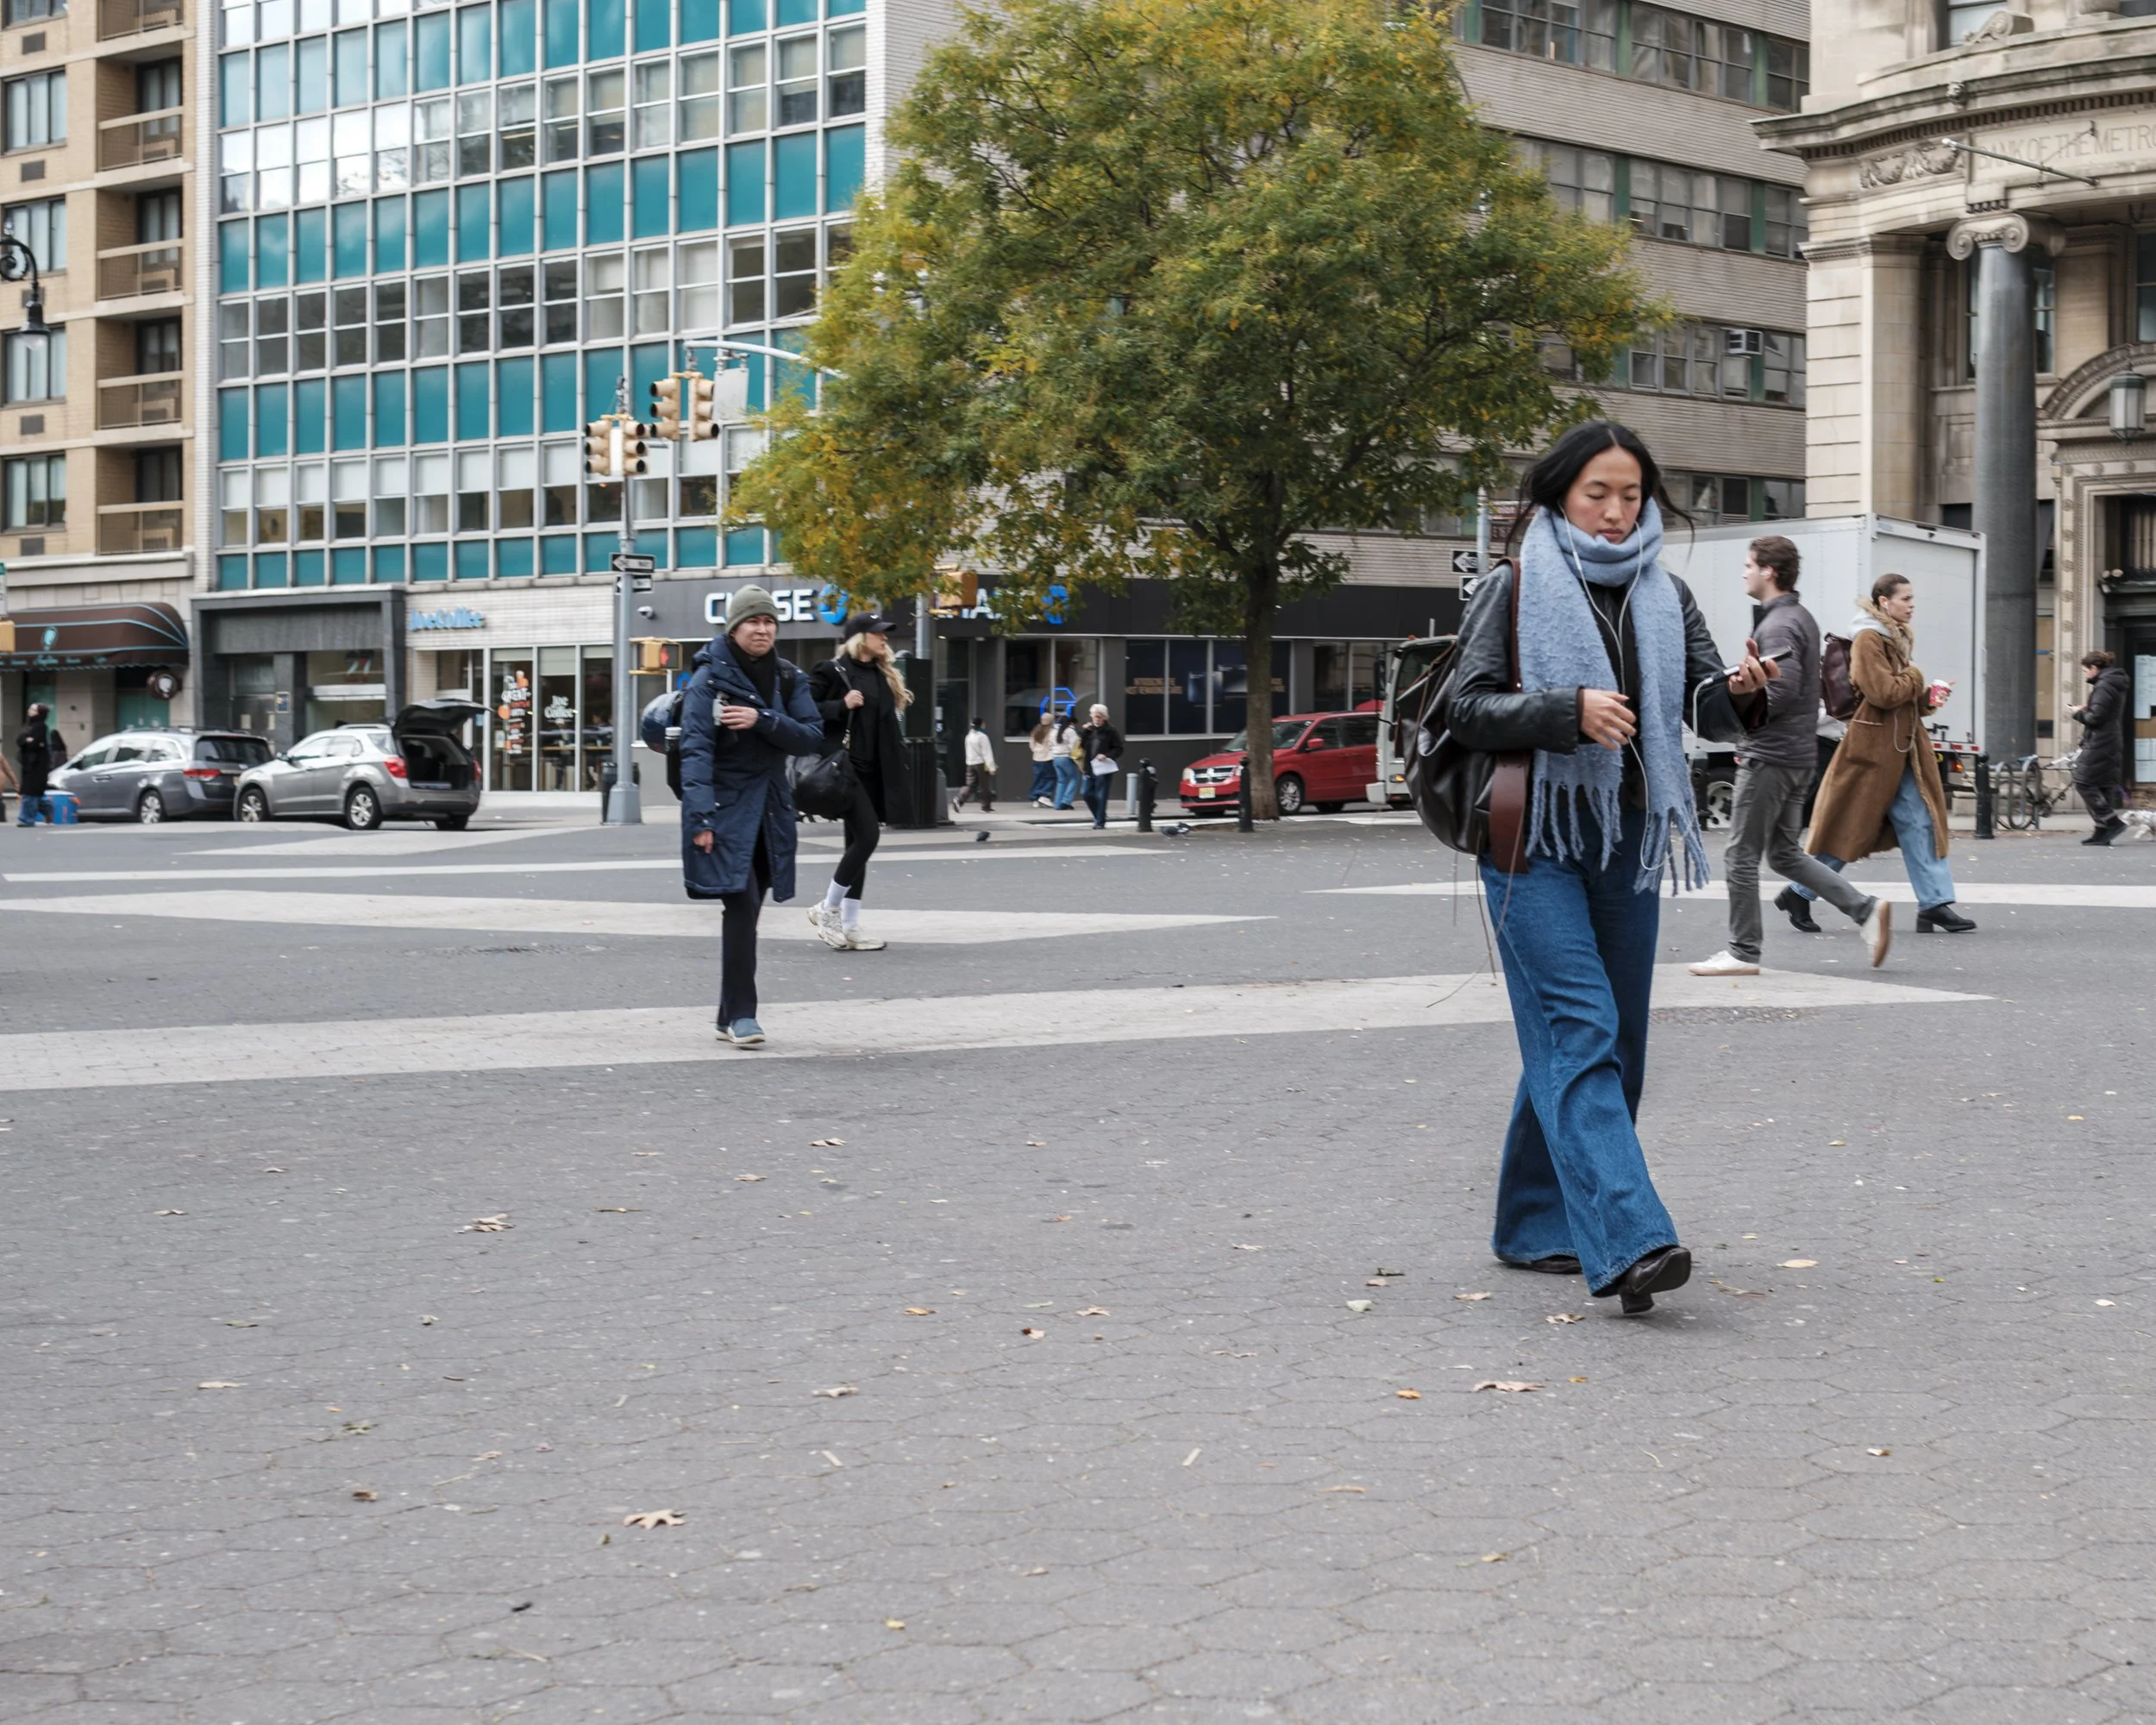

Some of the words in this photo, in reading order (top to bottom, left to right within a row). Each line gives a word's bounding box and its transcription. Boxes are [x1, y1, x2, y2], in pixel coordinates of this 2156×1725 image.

[1977, 138, 2027, 171] BANK
[2027, 135, 2053, 163] OF
[2054, 131, 2091, 160] THE
[705, 588, 815, 624] CSE
[544, 706, 573, 718] Coffee
[551, 695, 569, 708] Joe
